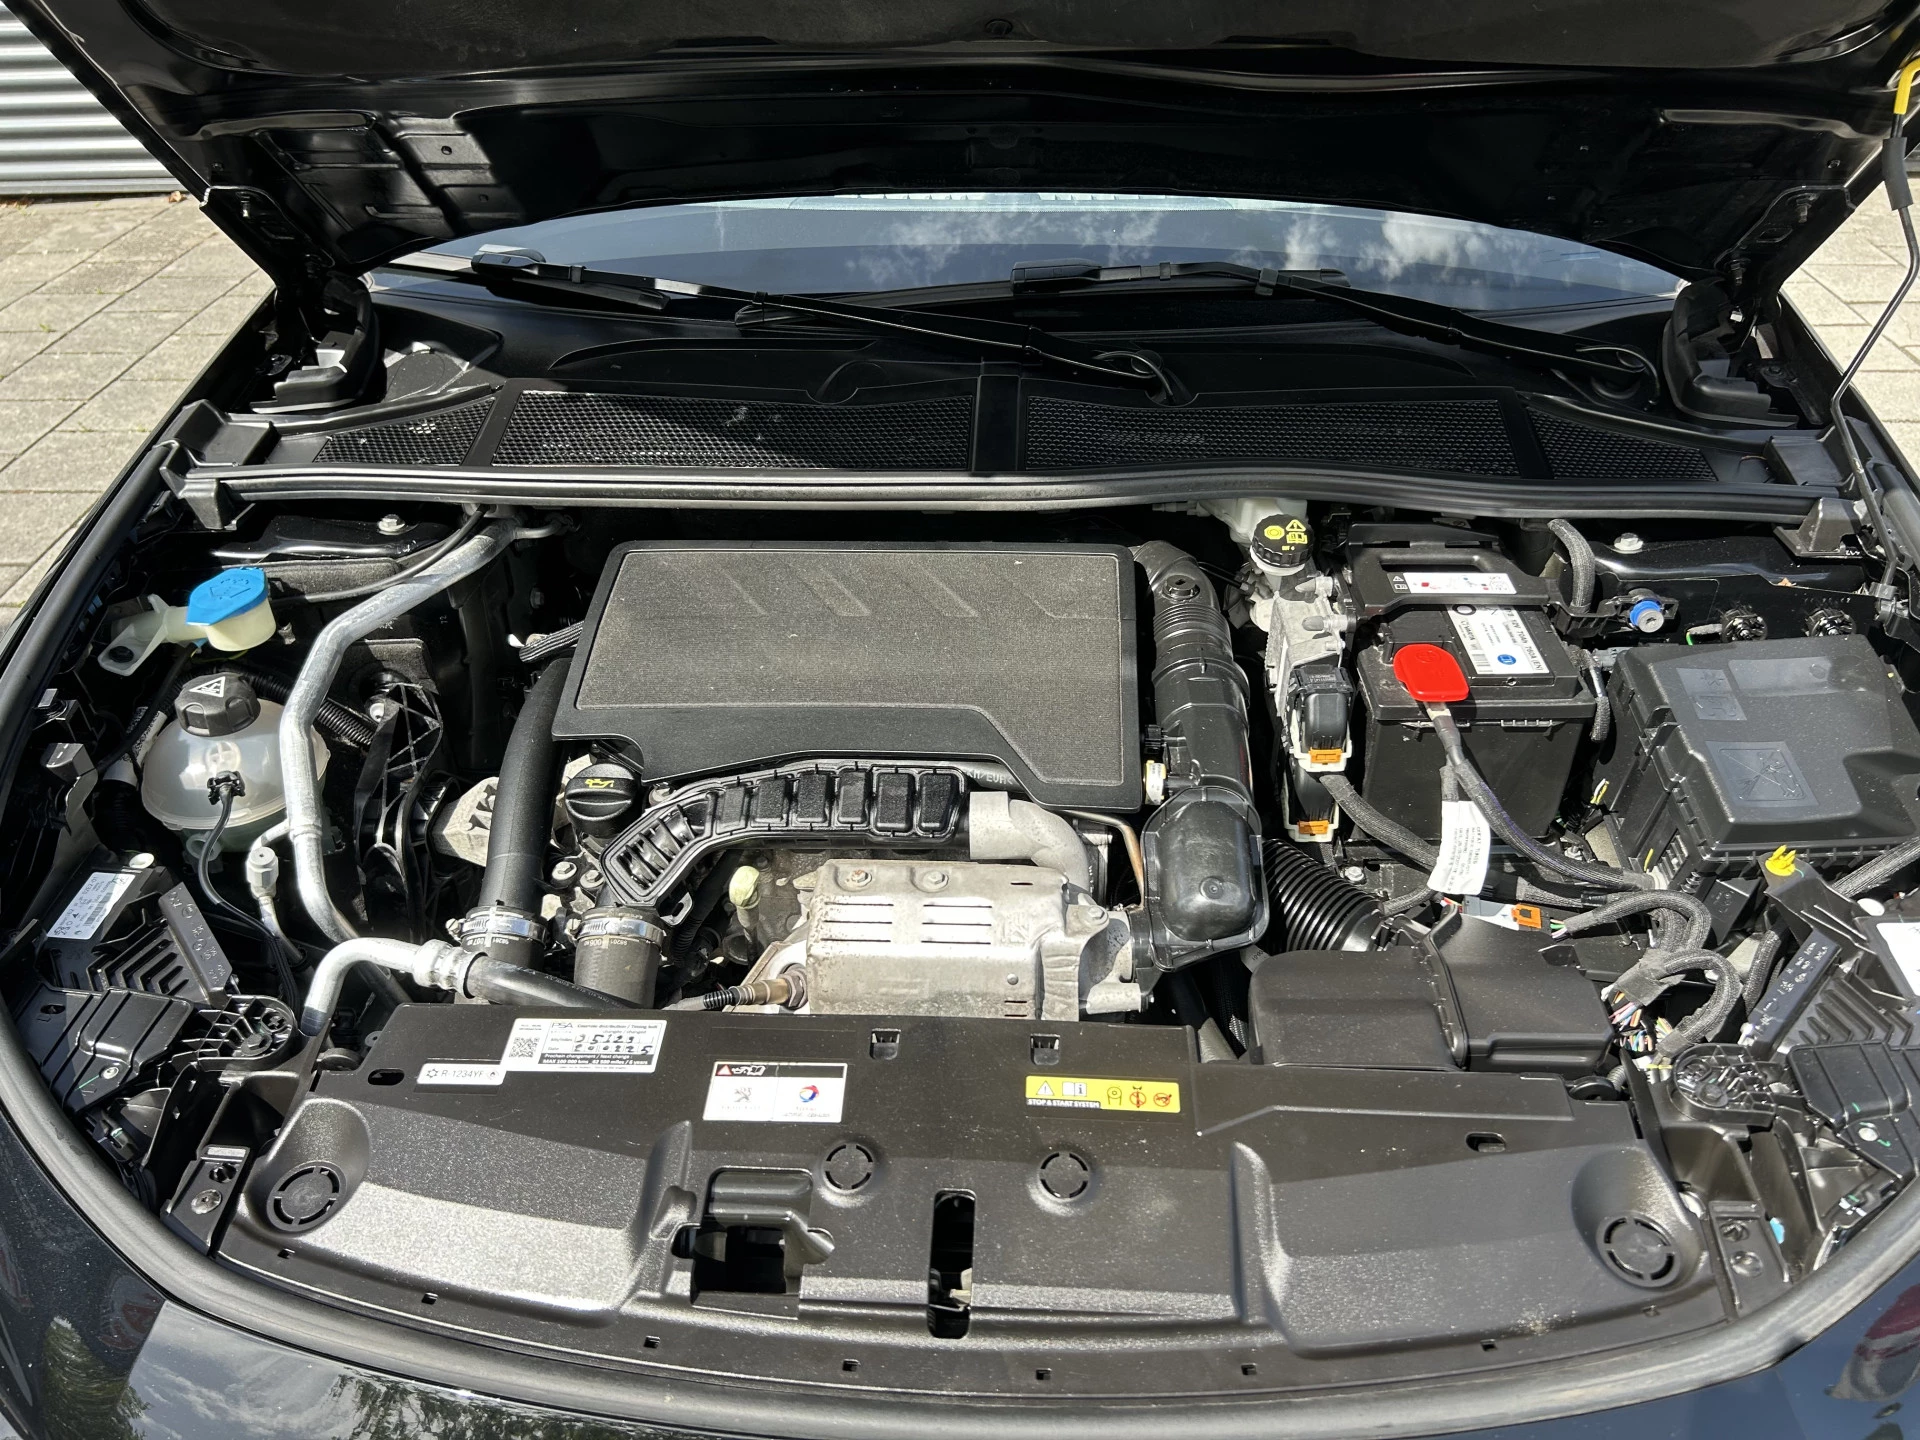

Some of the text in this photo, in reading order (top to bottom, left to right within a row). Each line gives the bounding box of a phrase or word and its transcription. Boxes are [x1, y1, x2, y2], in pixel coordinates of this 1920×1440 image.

[1531, 657, 1544, 671] (EN)
[440, 1069, 485, 1079] R-1234YF
[1027, 1098, 1046, 1106] STOP
[1052, 1099, 1074, 1107] START
[1073, 1100, 1100, 1109] SYSTEM
